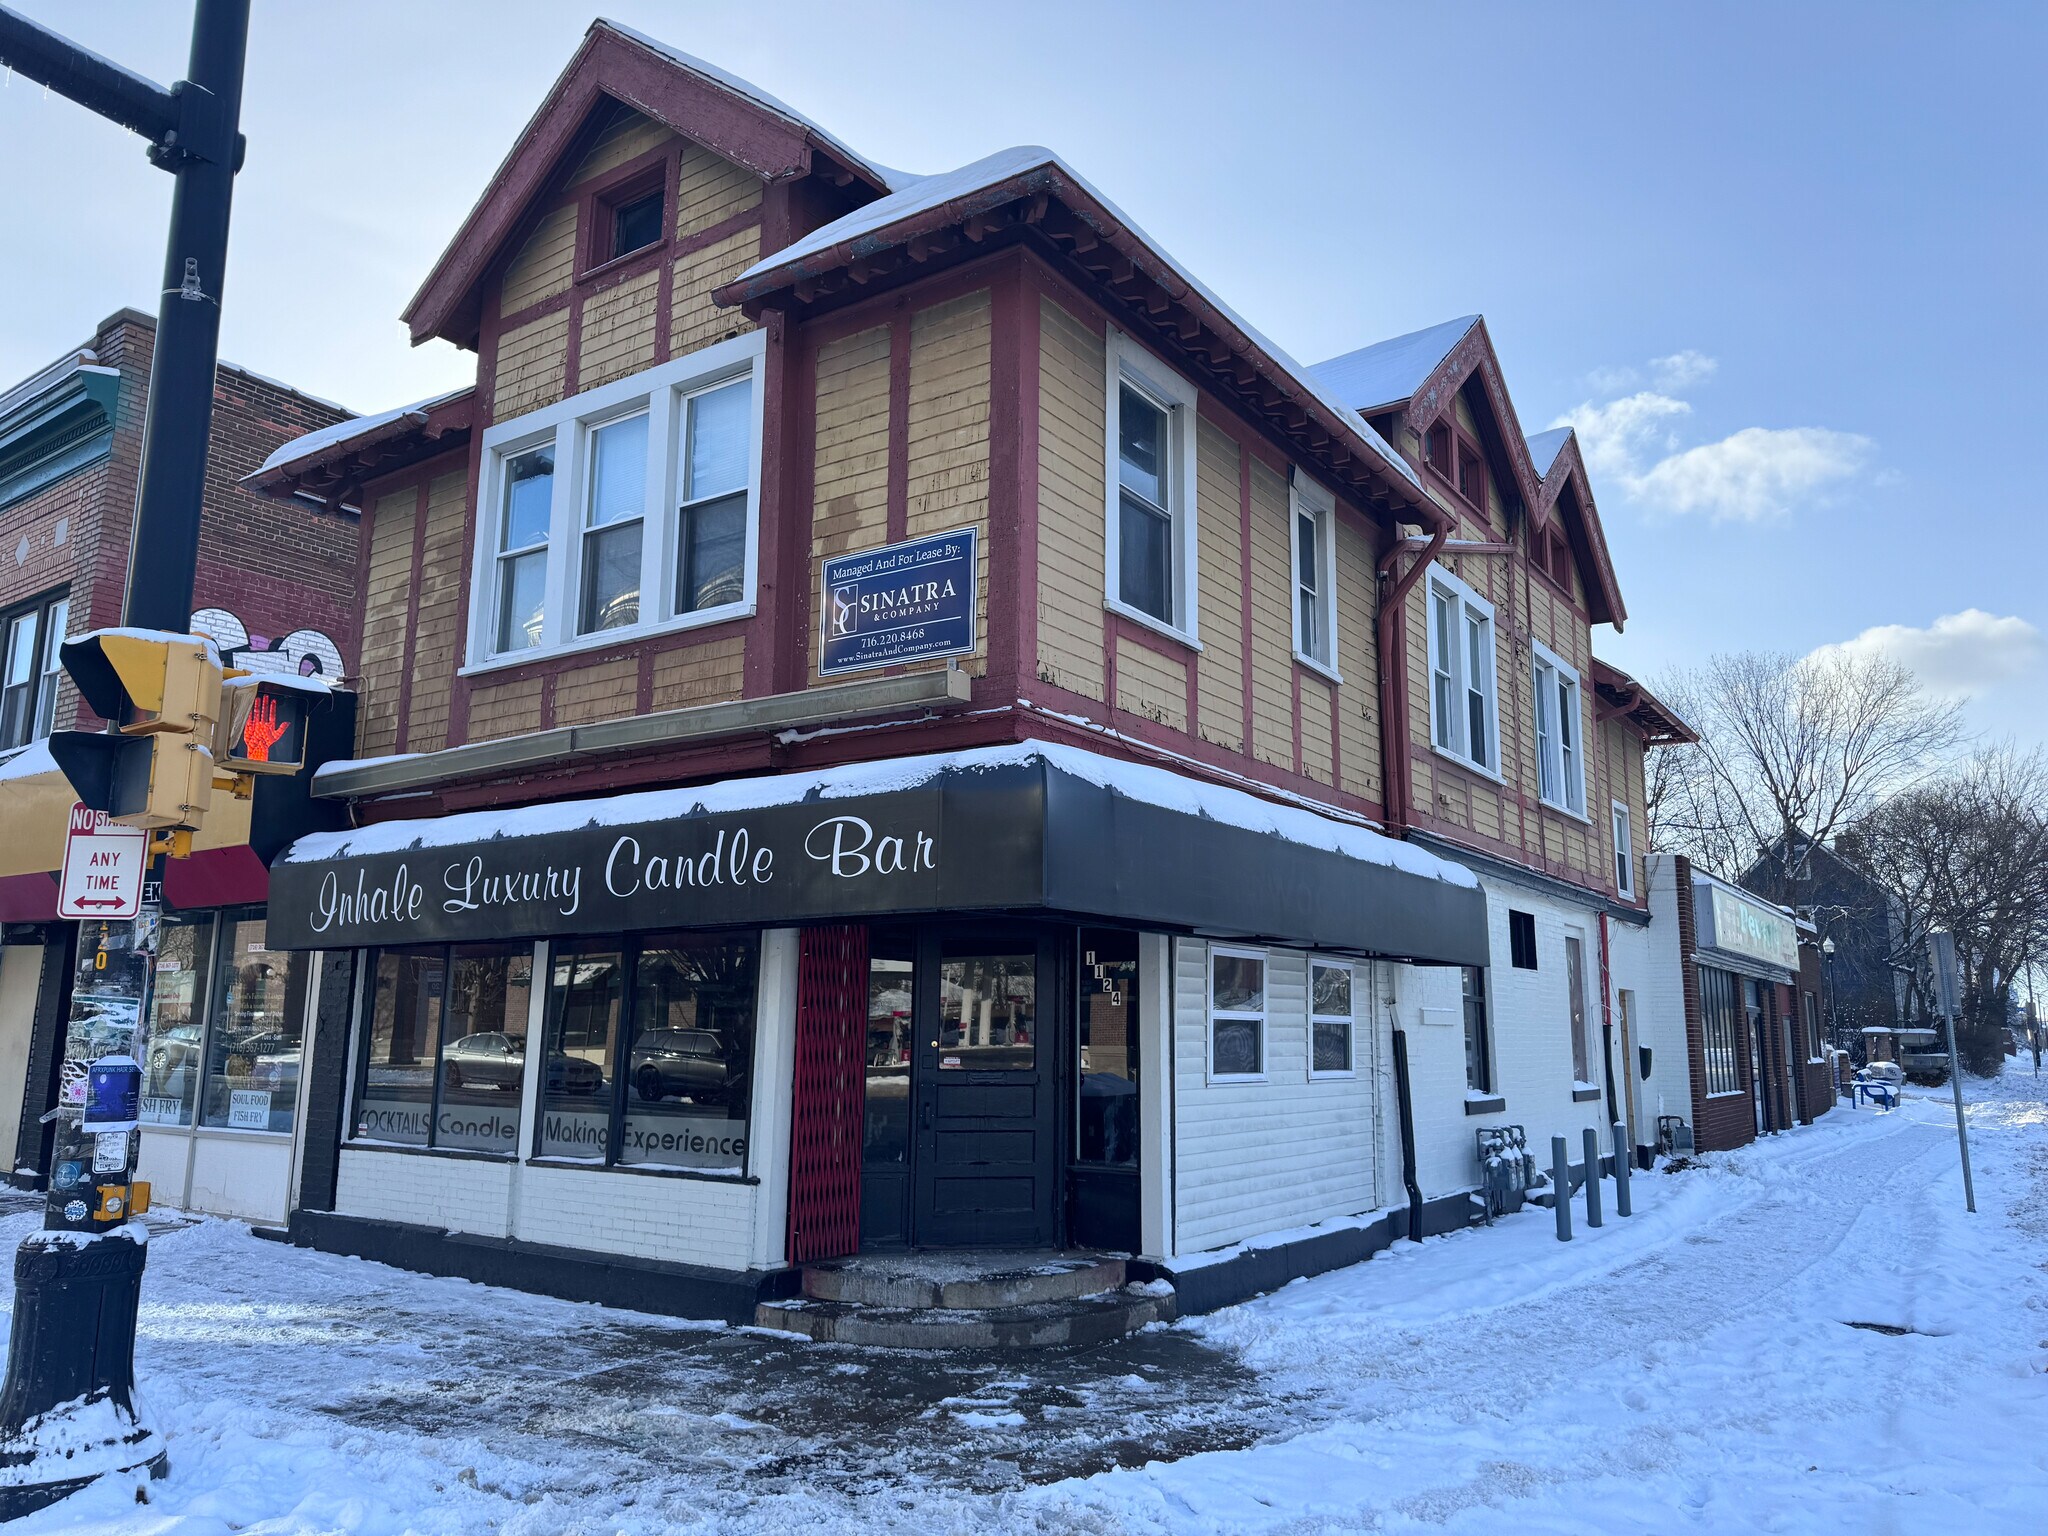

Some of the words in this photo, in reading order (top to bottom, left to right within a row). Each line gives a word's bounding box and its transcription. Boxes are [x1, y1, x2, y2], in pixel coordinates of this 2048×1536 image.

[833, 561, 873, 581] Managed
[875, 555, 896, 571] And
[898, 553, 913, 566] For
[916, 548, 943, 561] Lease
[945, 544, 961, 558] By:
[860, 578, 957, 614] SINATRA
[874, 613, 880, 622] &
[882, 602, 940, 620] COMPANY
[861, 629, 925, 649] 716.220.8468
[837, 639, 952, 664] www.SinatraAndCompany.com
[72, 809, 94, 830] NO
[90, 852, 121, 867] ANY
[86, 875, 120, 890] TIME
[310, 864, 424, 933] Inhale
[442, 855, 582, 916] Luxury
[605, 827, 774, 898] Candle
[804, 815, 937, 878] Bar
[246, 1042, 275, 1053] 367-1277
[142, 1098, 157, 1113] SH
[159, 1099, 179, 1115] FRY
[232, 1094, 249, 1105] SOUL
[250, 1095, 269, 1106] FOOD
[233, 1111, 249, 1122] FISH
[249, 1111, 265, 1123] FRY
[359, 1109, 430, 1136] COCKTAILS
[437, 1112, 516, 1140] Candle
[545, 1117, 609, 1151] Making
[623, 1128, 746, 1157] Experience
